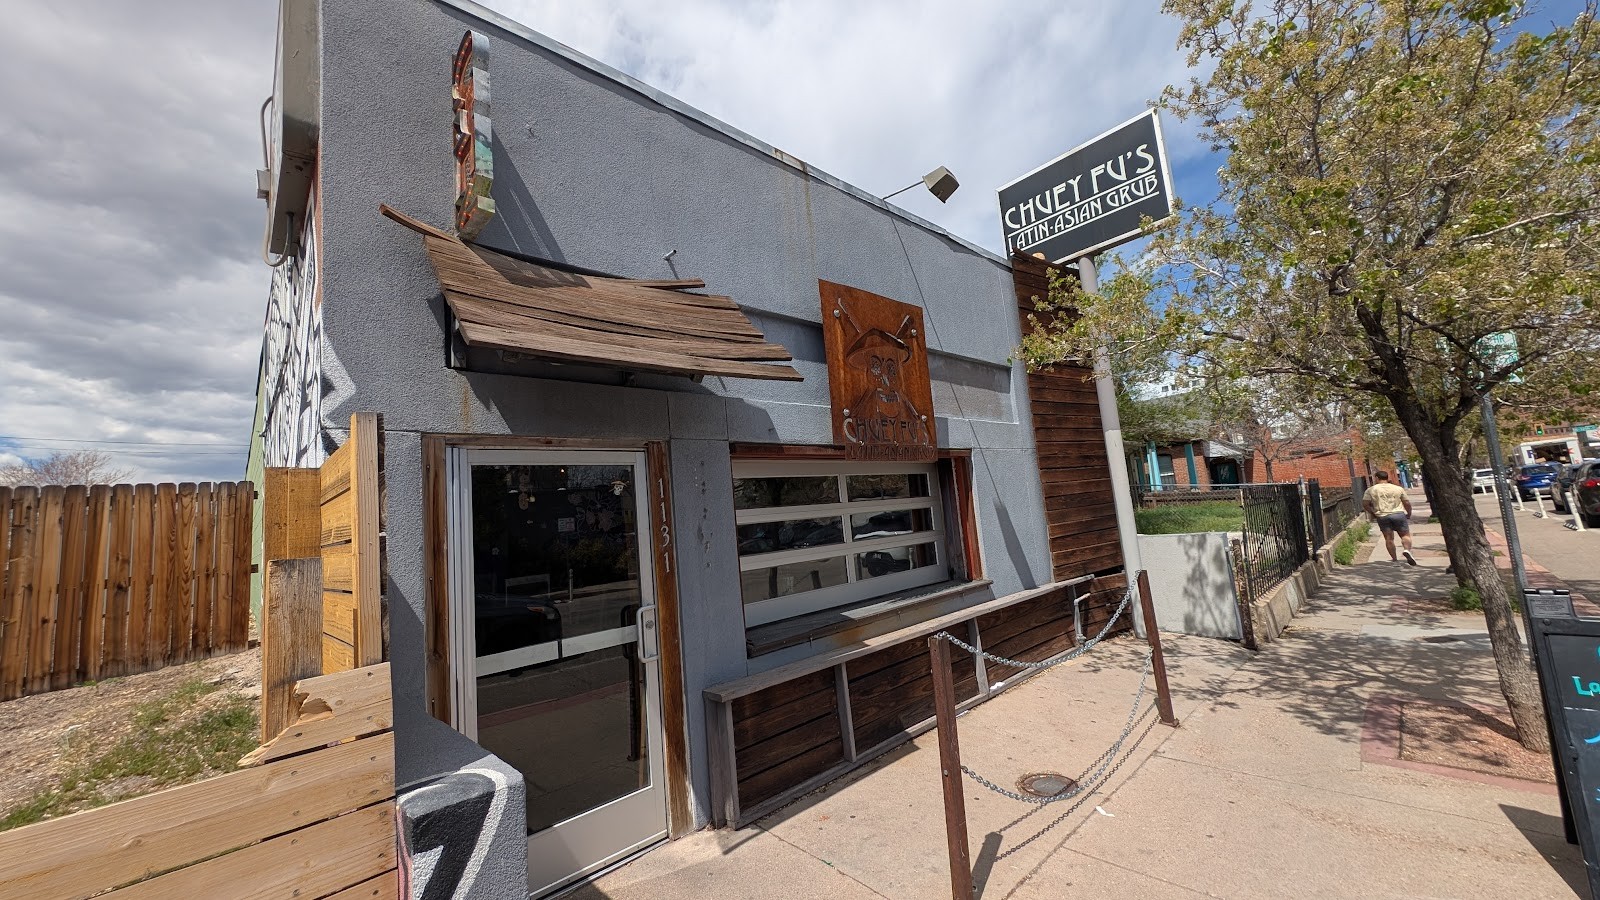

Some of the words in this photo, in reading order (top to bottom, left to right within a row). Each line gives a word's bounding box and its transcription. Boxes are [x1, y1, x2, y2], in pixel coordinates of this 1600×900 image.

[1004, 174, 1083, 229] CHUEY
[1090, 144, 1155, 195] FU'S
[1007, 199, 1103, 256] LATIN-ASIAN
[1106, 174, 1158, 207] GRUB
[843, 418, 897, 444] CHUEY
[657, 477, 671, 573] 1131
